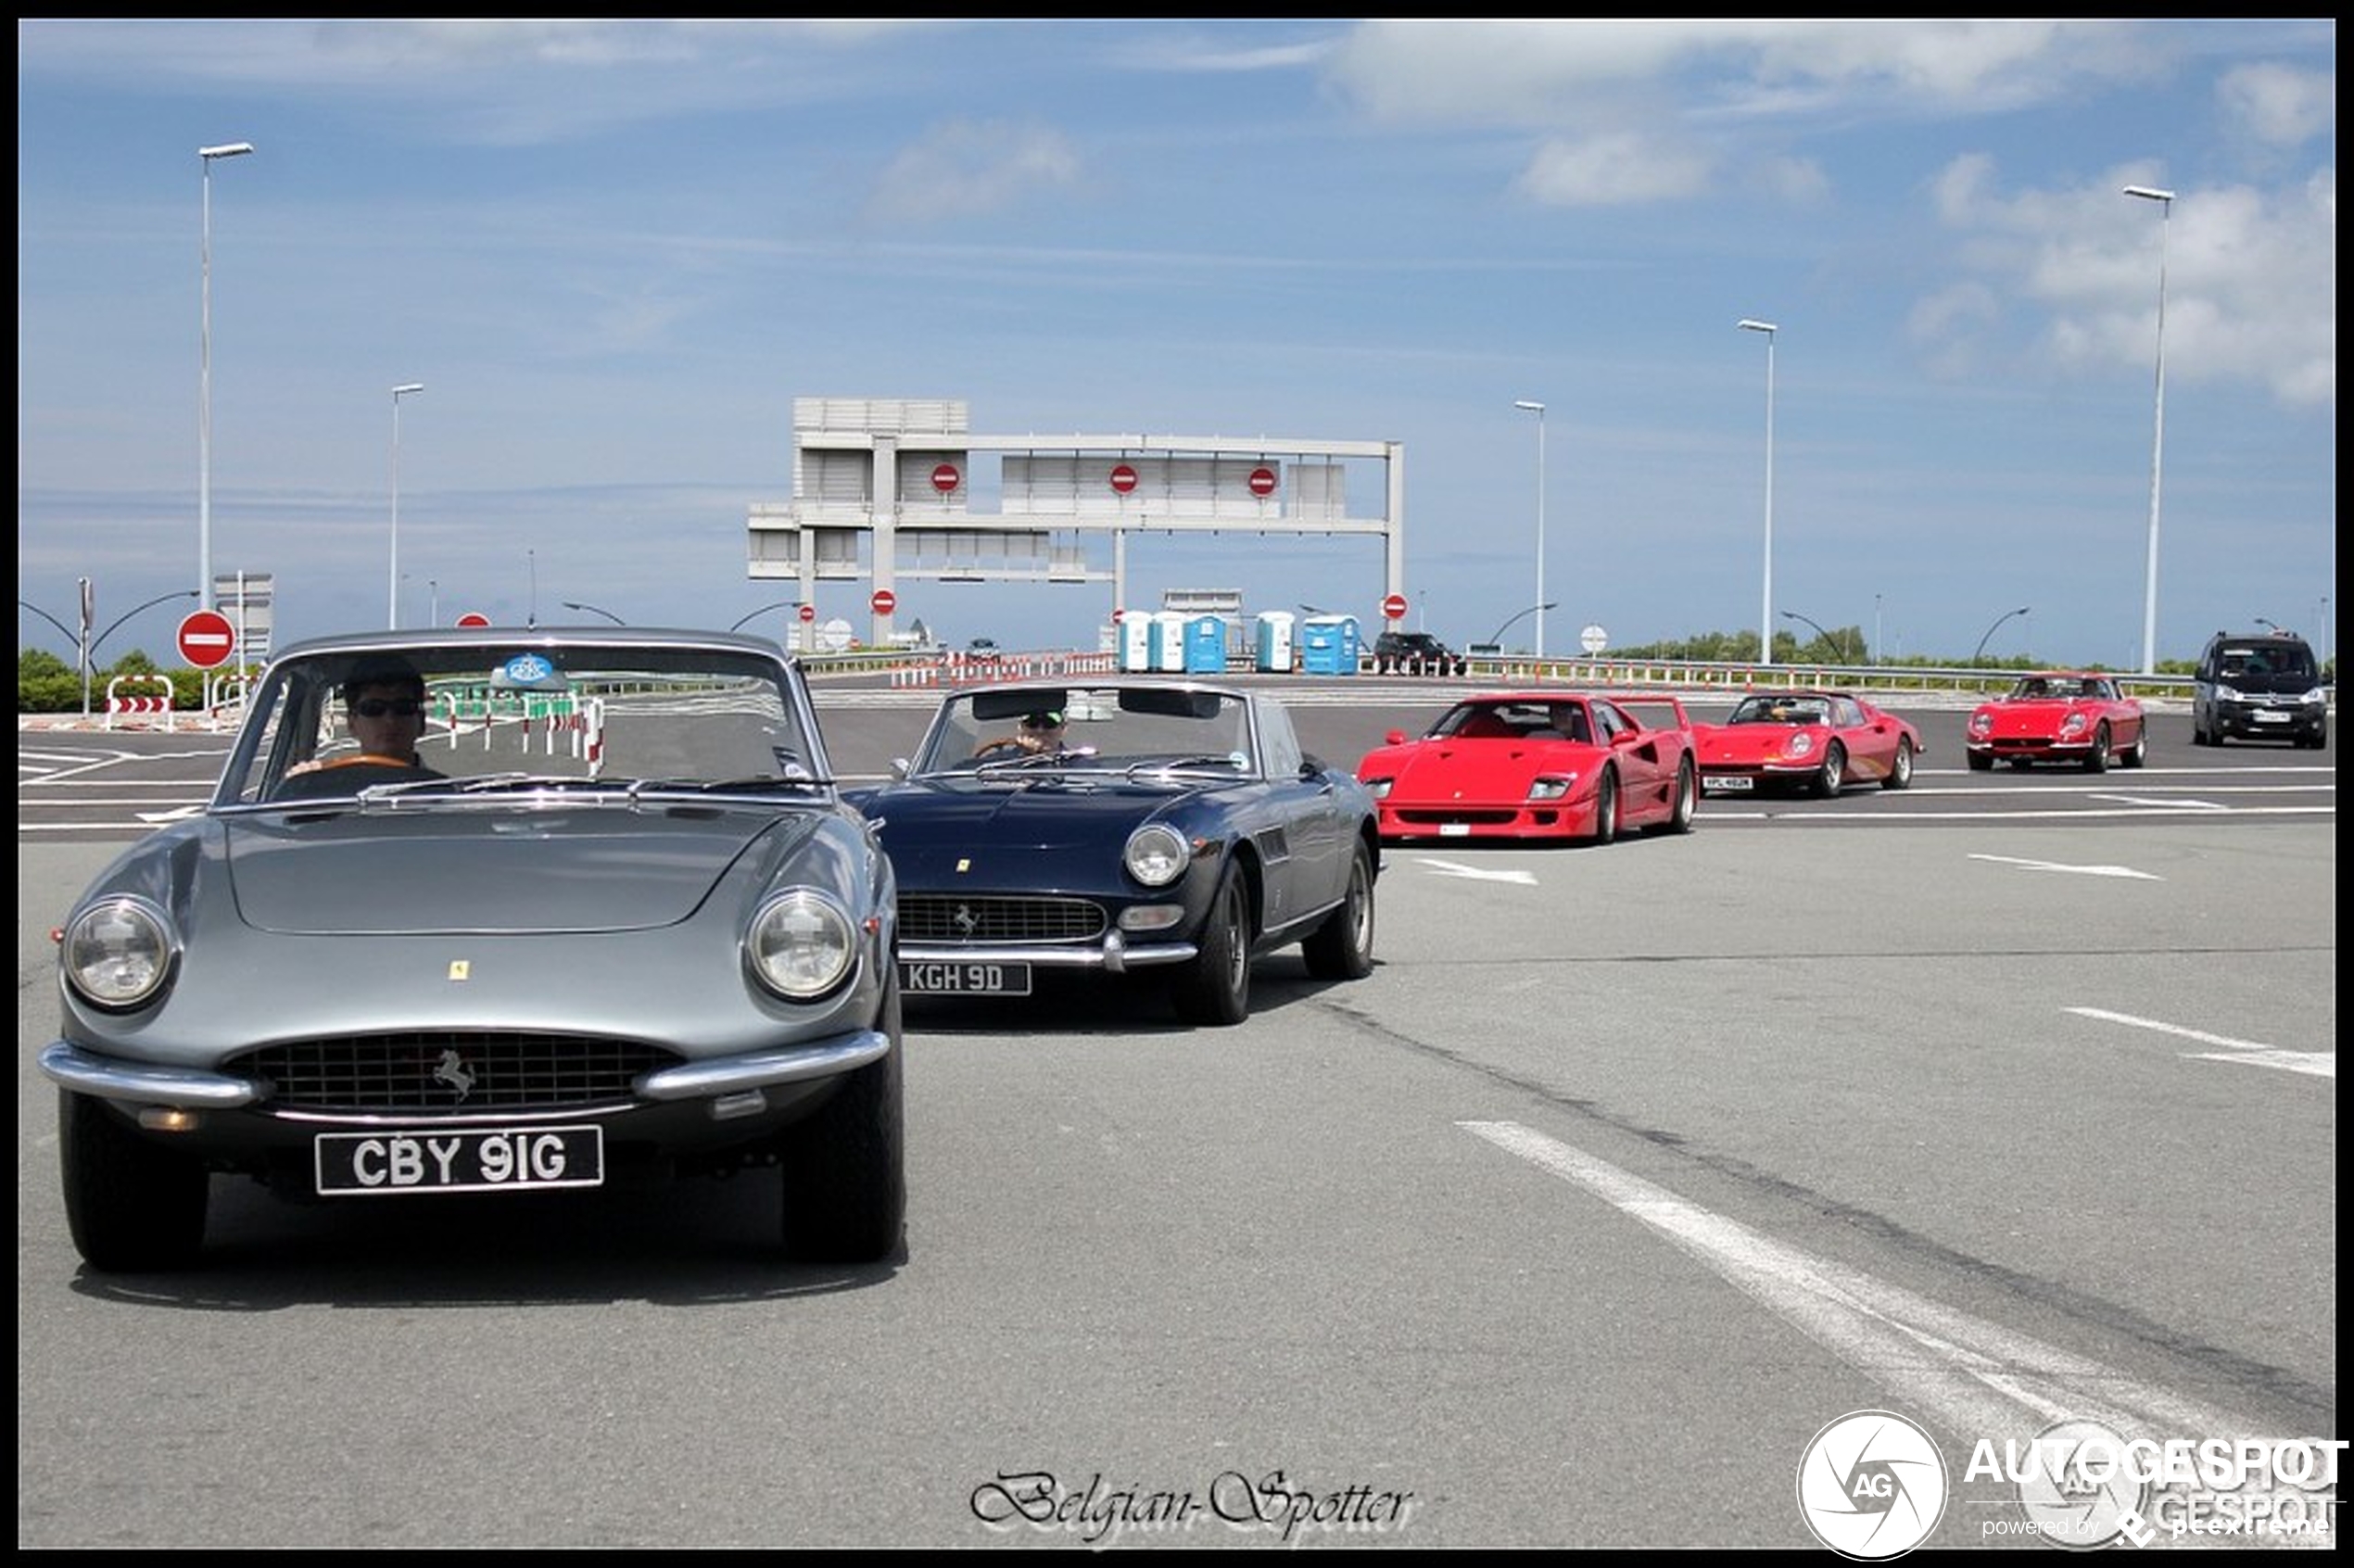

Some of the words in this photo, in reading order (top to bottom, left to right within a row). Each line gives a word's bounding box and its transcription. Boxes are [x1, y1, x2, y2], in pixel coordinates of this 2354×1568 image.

[909, 965, 961, 990] KGH
[968, 965, 1003, 991] 9D
[353, 1138, 462, 1186] CBY
